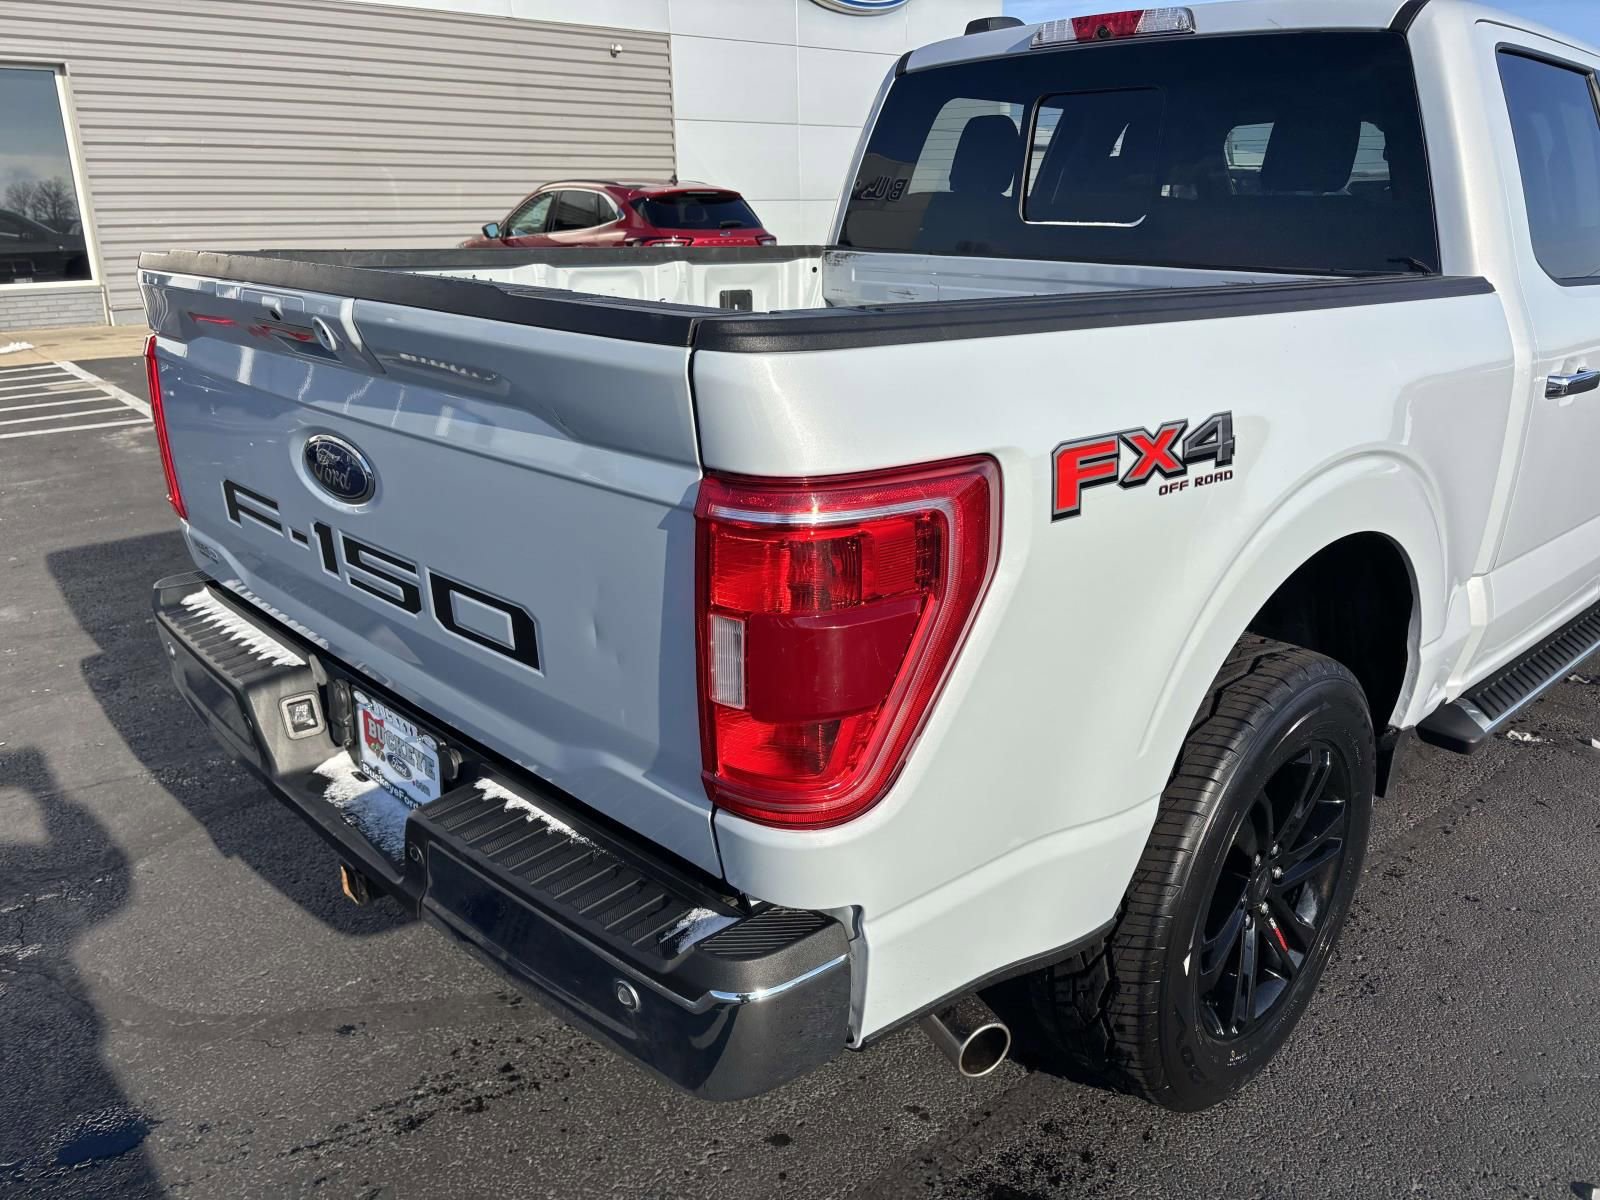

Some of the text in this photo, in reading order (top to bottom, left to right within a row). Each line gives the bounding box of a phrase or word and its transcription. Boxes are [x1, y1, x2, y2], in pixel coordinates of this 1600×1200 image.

[1051, 410, 1235, 523] FX4
[1159, 470, 1233, 496] OFF ROAD
[220, 478, 545, 678] F-150
[368, 718, 436, 781] BUCKEYE
[390, 756, 408, 776] Ford
